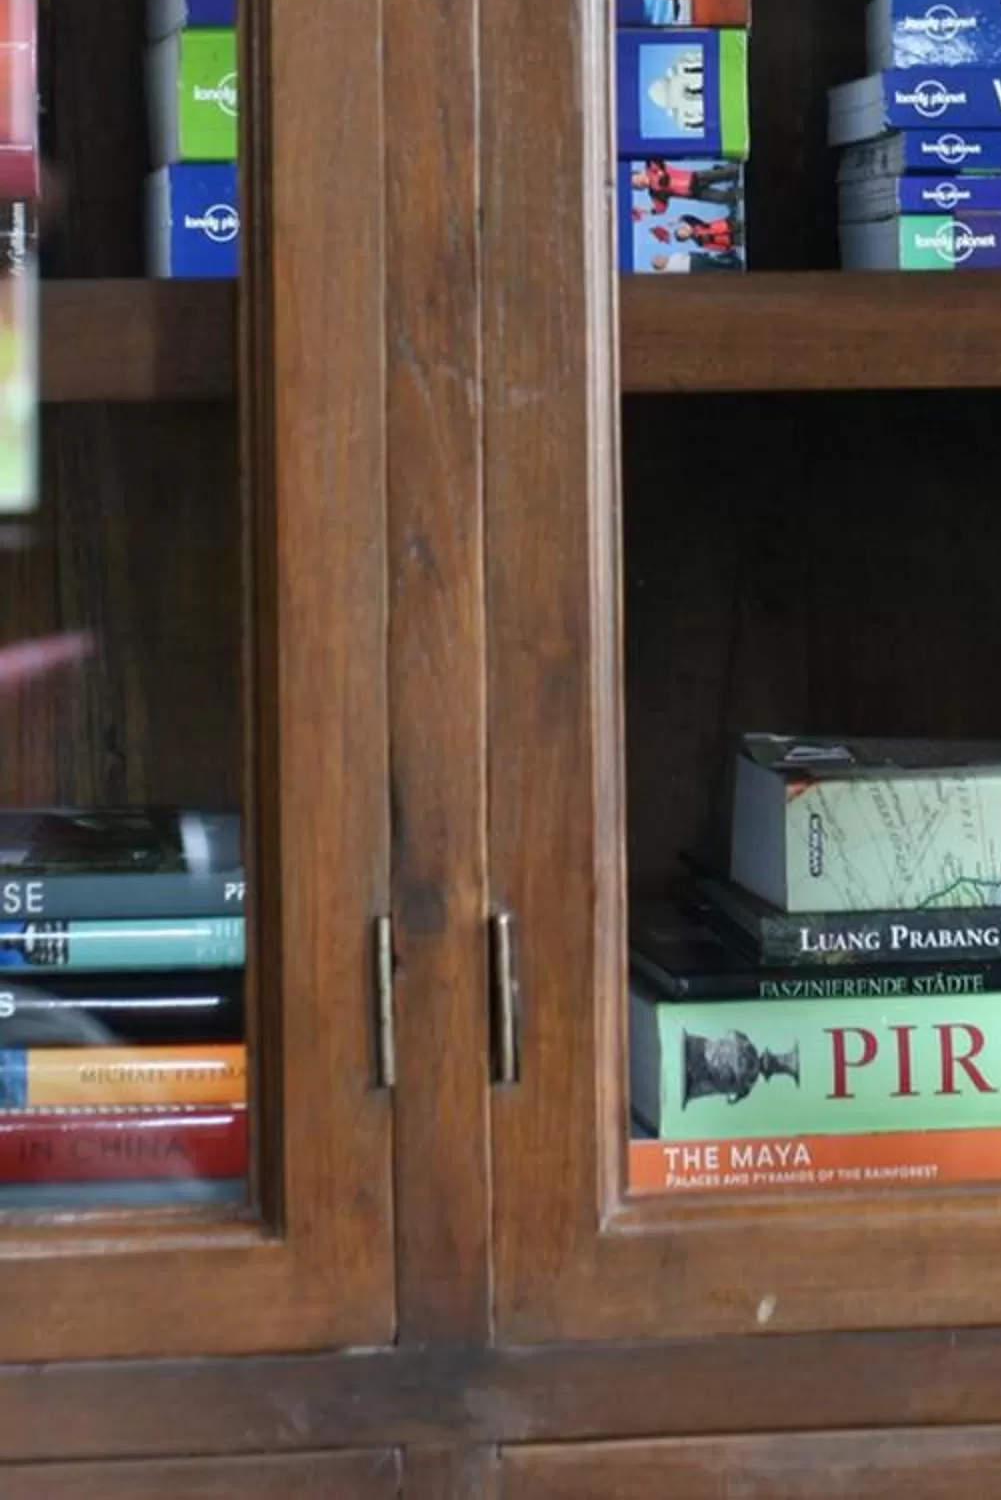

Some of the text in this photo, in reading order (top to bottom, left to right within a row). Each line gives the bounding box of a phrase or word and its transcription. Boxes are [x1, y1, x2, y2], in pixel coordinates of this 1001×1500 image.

[896, 91, 966, 109] lonely planet
[914, 233, 996, 252] lonely planet
[800, 927, 881, 952] LUANG
[891, 925, 1000, 950] PRABANG
[760, 976, 908, 998] FASZINIERENDE
[664, 1143, 812, 1170] THE MAYA
